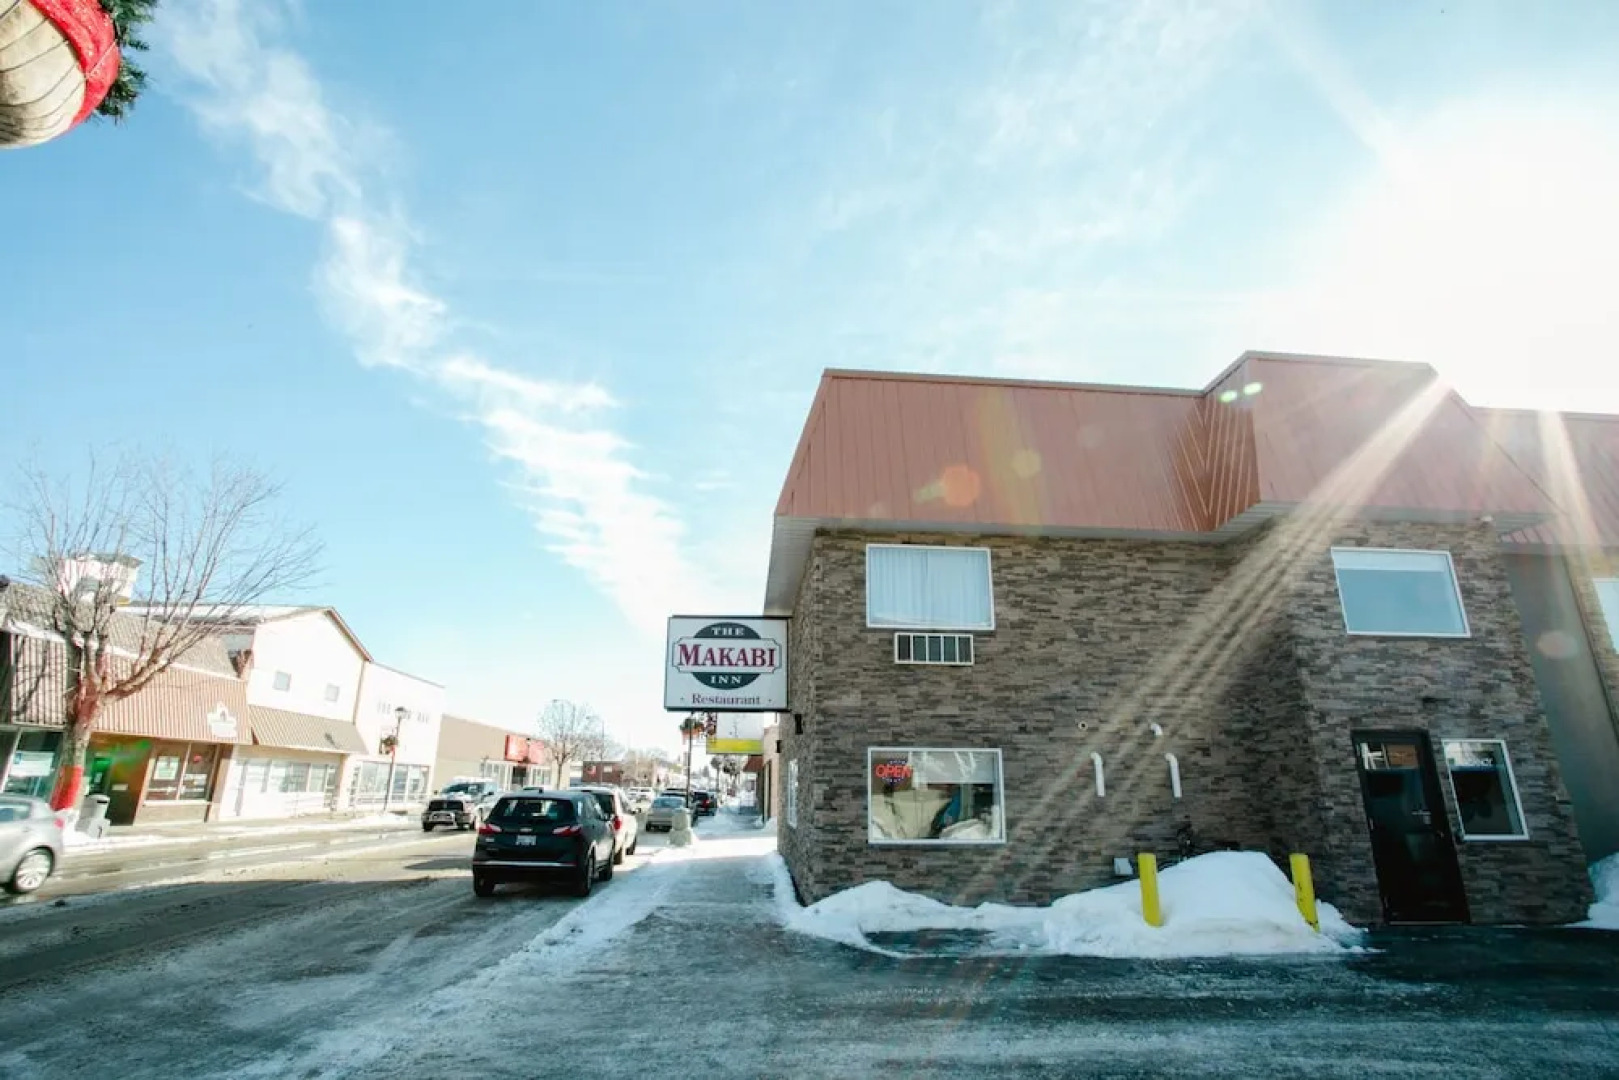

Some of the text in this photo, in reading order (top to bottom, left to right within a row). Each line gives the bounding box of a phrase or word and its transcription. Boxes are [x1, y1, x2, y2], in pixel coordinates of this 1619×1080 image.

[711, 627, 745, 636] THE
[678, 643, 776, 668] MAKABI
[710, 675, 742, 684] INN
[692, 693, 760, 705] Restaurant
[875, 764, 912, 778] OPEN
